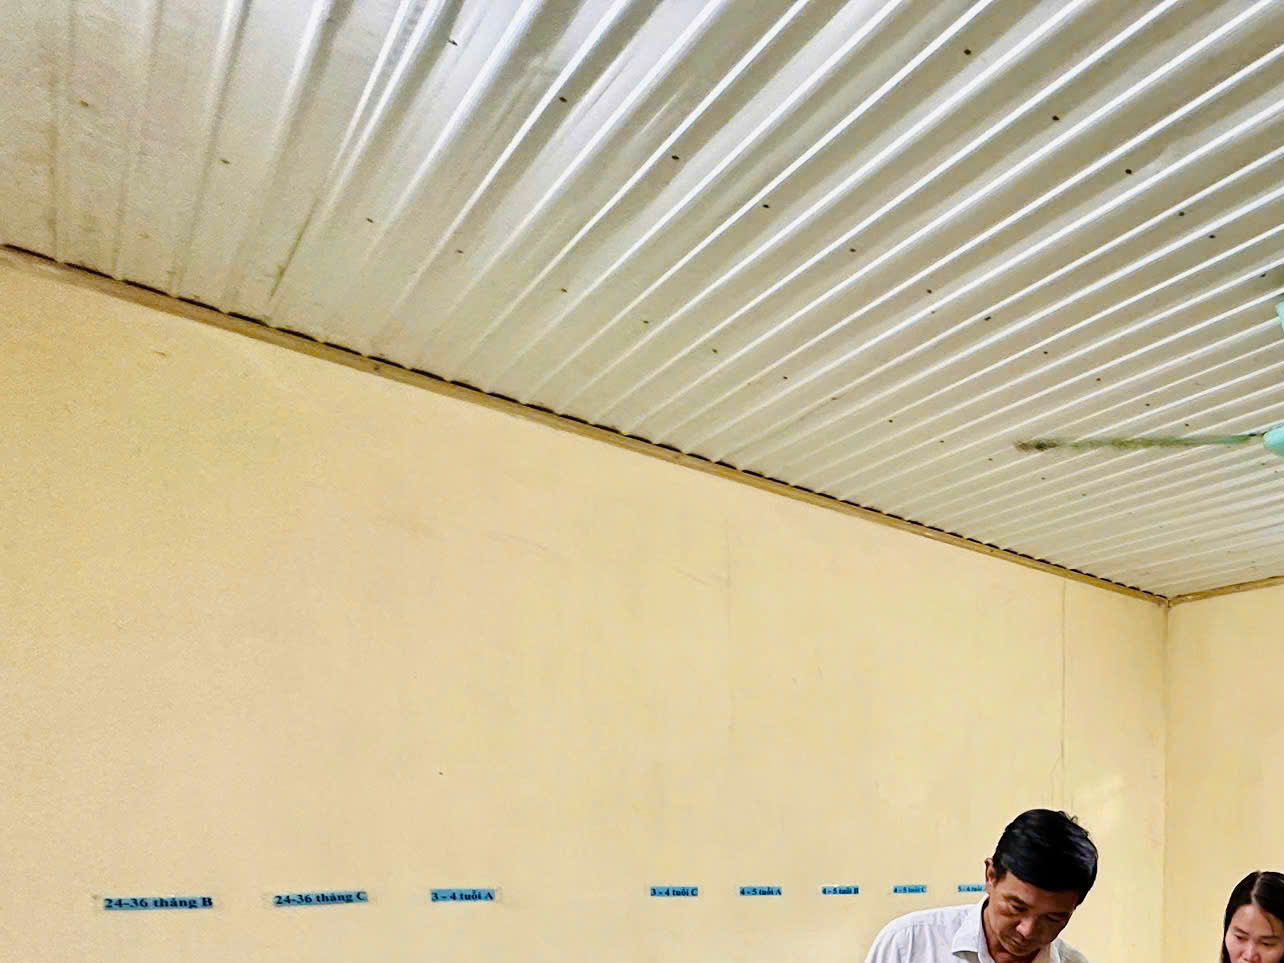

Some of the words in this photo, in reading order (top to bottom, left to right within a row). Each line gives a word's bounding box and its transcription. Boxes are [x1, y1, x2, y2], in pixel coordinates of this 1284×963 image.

[275, 894, 313, 905] 24-36
[316, 893, 355, 904] tháng
[356, 891, 368, 901] C
[449, 892, 457, 901] 4
[459, 889, 482, 901] tuổi
[484, 892, 494, 900] A
[104, 898, 149, 909] 24-36
[153, 897, 198, 909] tháng
[202, 897, 213, 907] B
